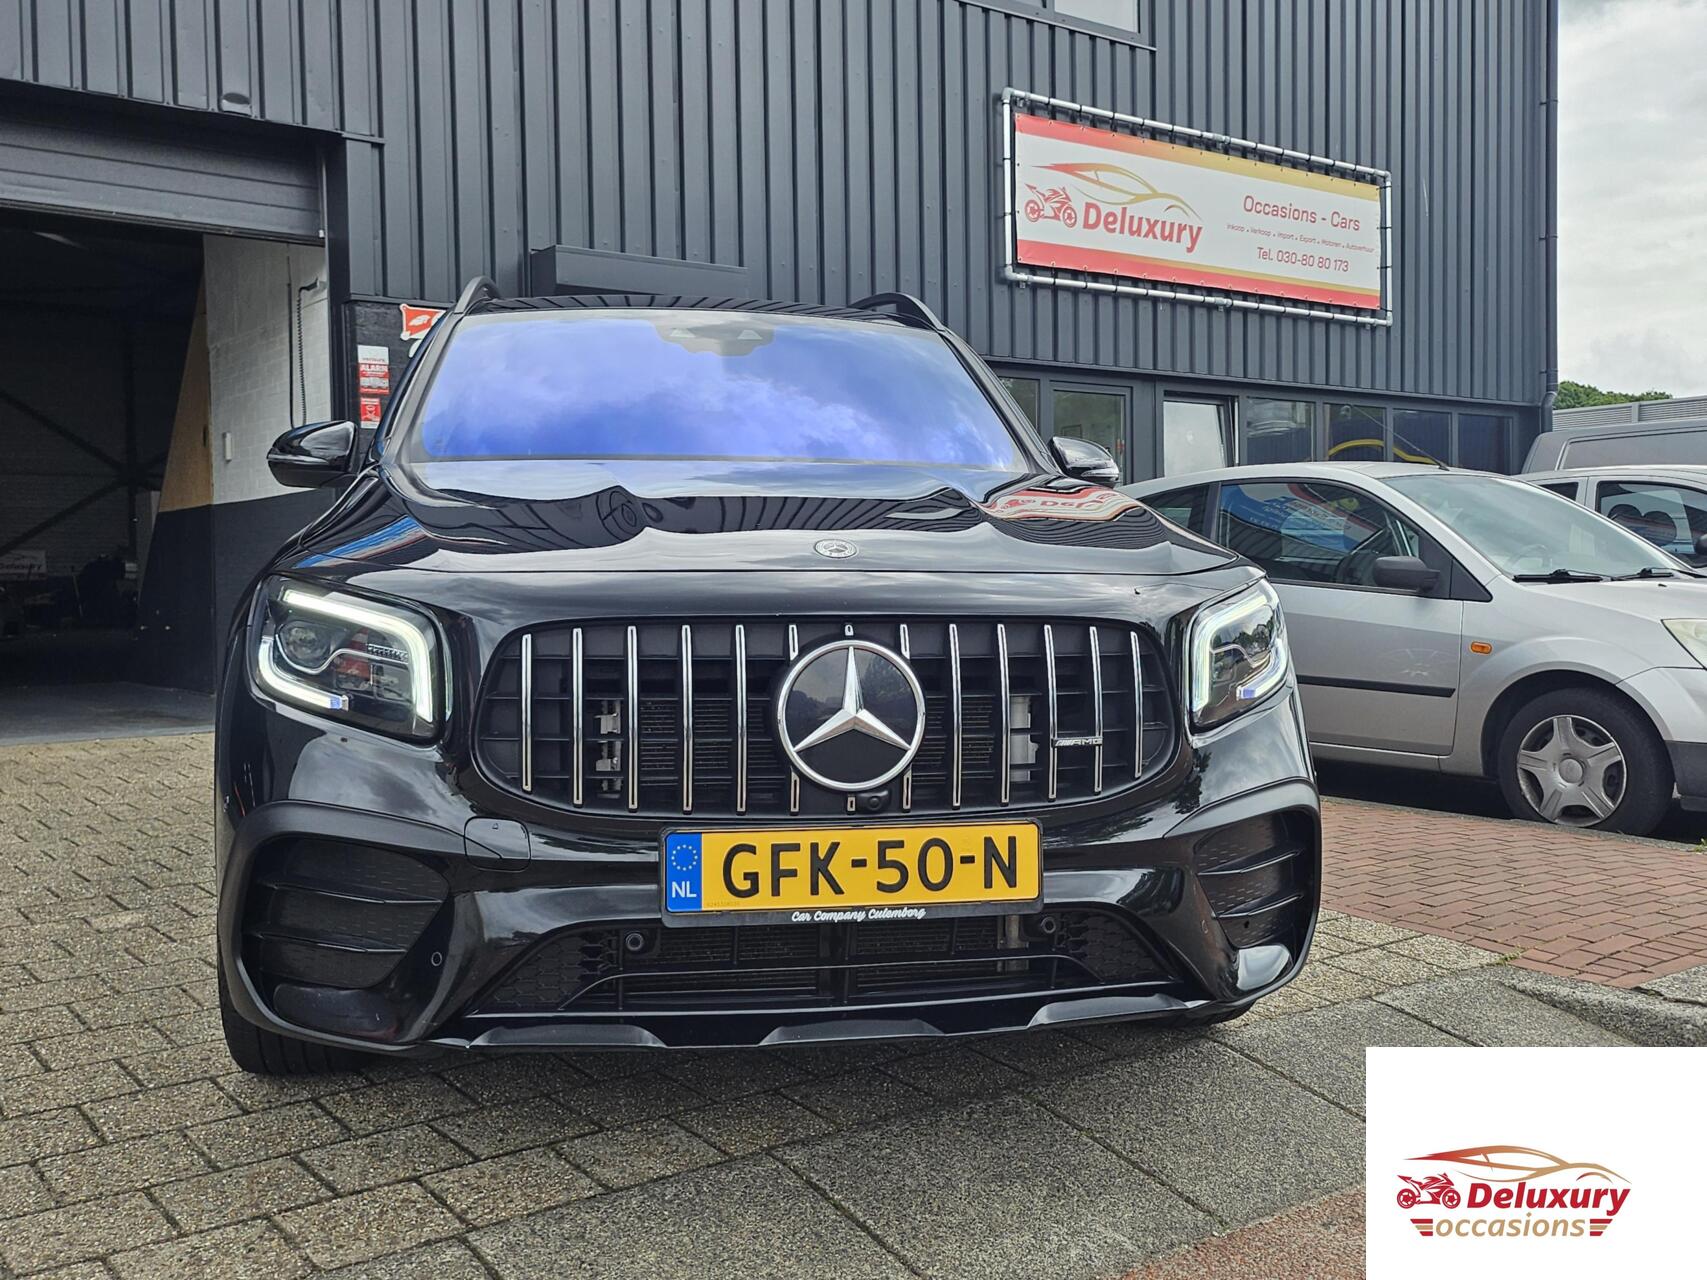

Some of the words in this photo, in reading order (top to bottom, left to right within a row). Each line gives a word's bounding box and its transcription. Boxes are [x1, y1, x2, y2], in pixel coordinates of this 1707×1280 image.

[1082, 201, 1203, 253] Deluxury
[1243, 195, 1317, 224] Occasions
[1330, 211, 1360, 231] Cars
[1257, 246, 1274, 261] Tel.
[1276, 250, 1315, 267] 030-80
[1317, 256, 1331, 270] 80
[1334, 259, 1349, 272] 173
[722, 836, 1017, 899] GFK-50-N
[671, 881, 697, 898] NL
[791, 911, 812, 922] Car
[813, 908, 867, 923] Company
[867, 906, 927, 920] Culemborg
